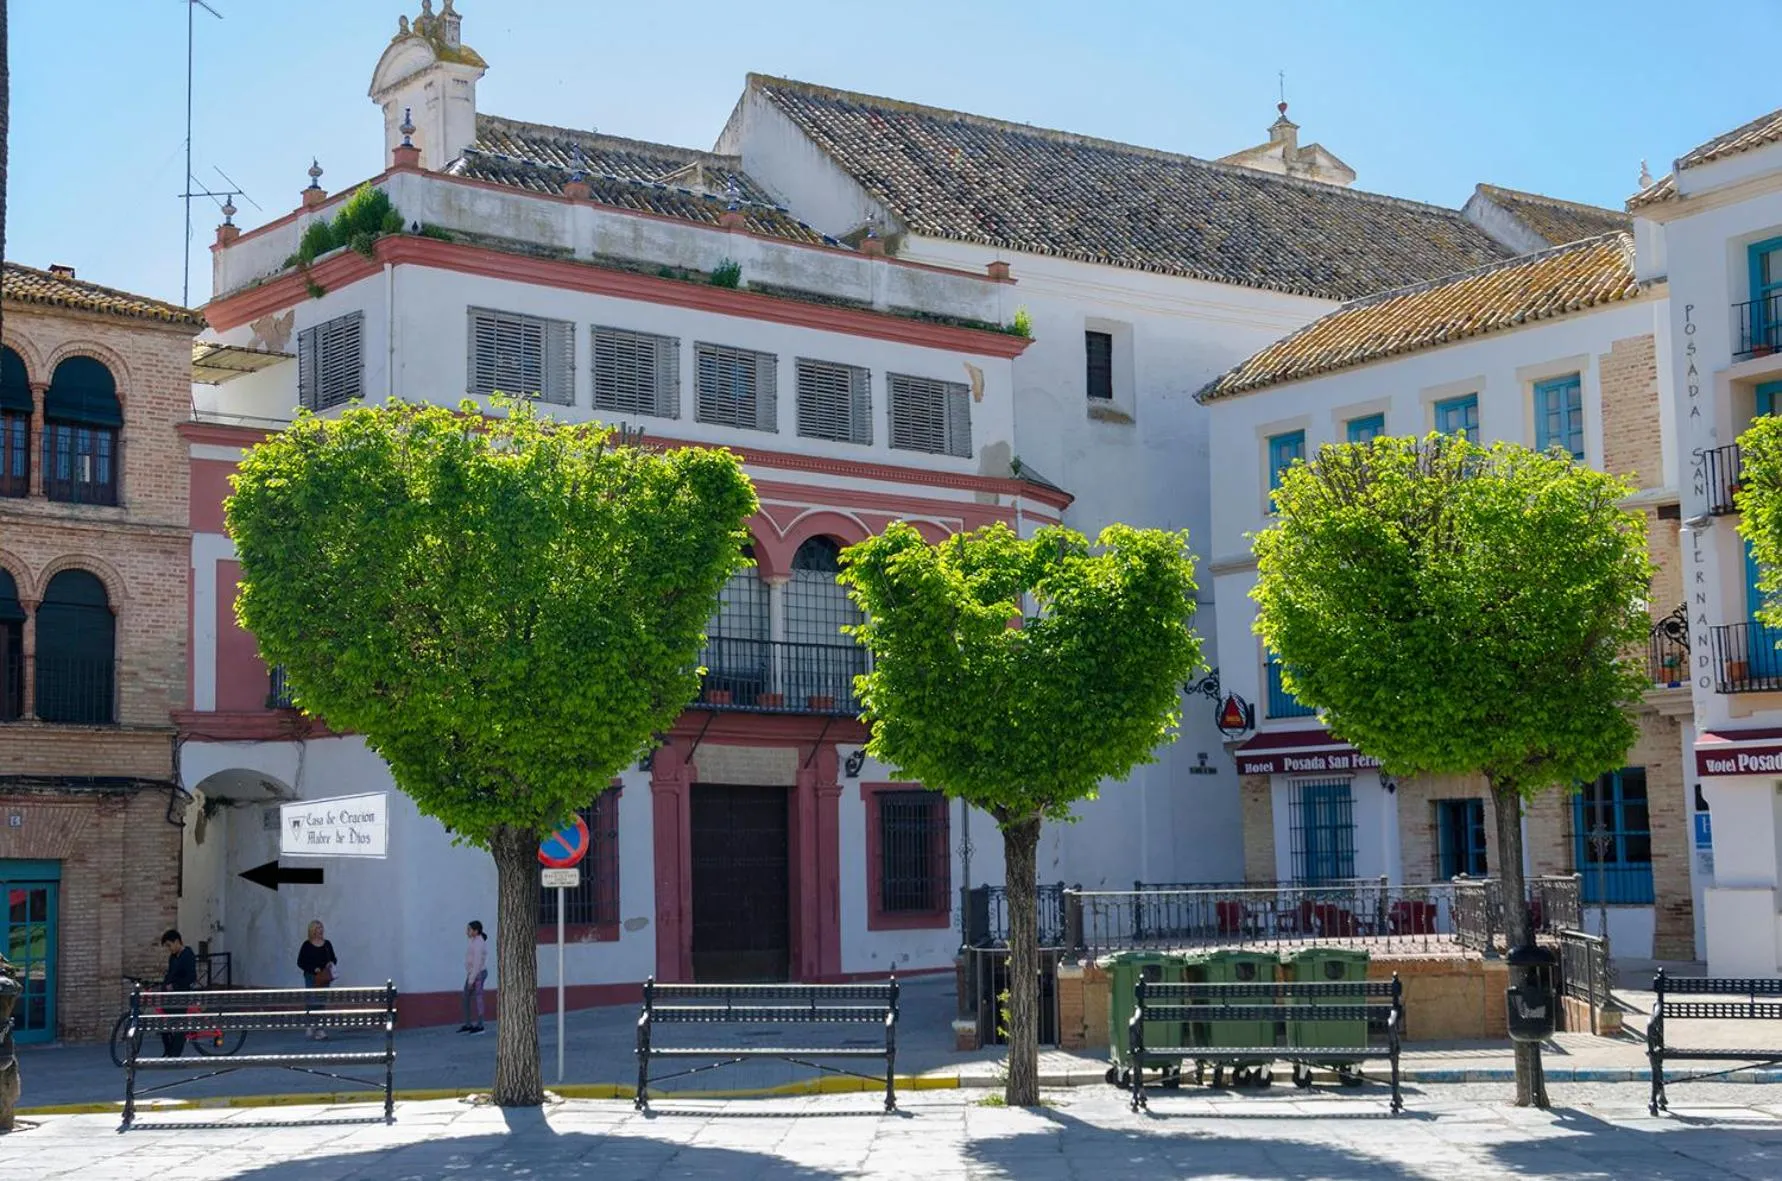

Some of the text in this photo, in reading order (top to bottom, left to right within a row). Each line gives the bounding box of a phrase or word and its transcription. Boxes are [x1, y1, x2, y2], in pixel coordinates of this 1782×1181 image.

[1685, 304, 1711, 689] POSADA SAN FERNANDO
[1244, 762, 1274, 773] Hotel
[1284, 756, 1325, 771] Posada
[1328, 755, 1349, 769] San
[1706, 759, 1737, 772] Hotel
[306, 812, 324, 826] Casa
[327, 811, 336, 825] de
[307, 827, 371, 845] Madre de Dios
